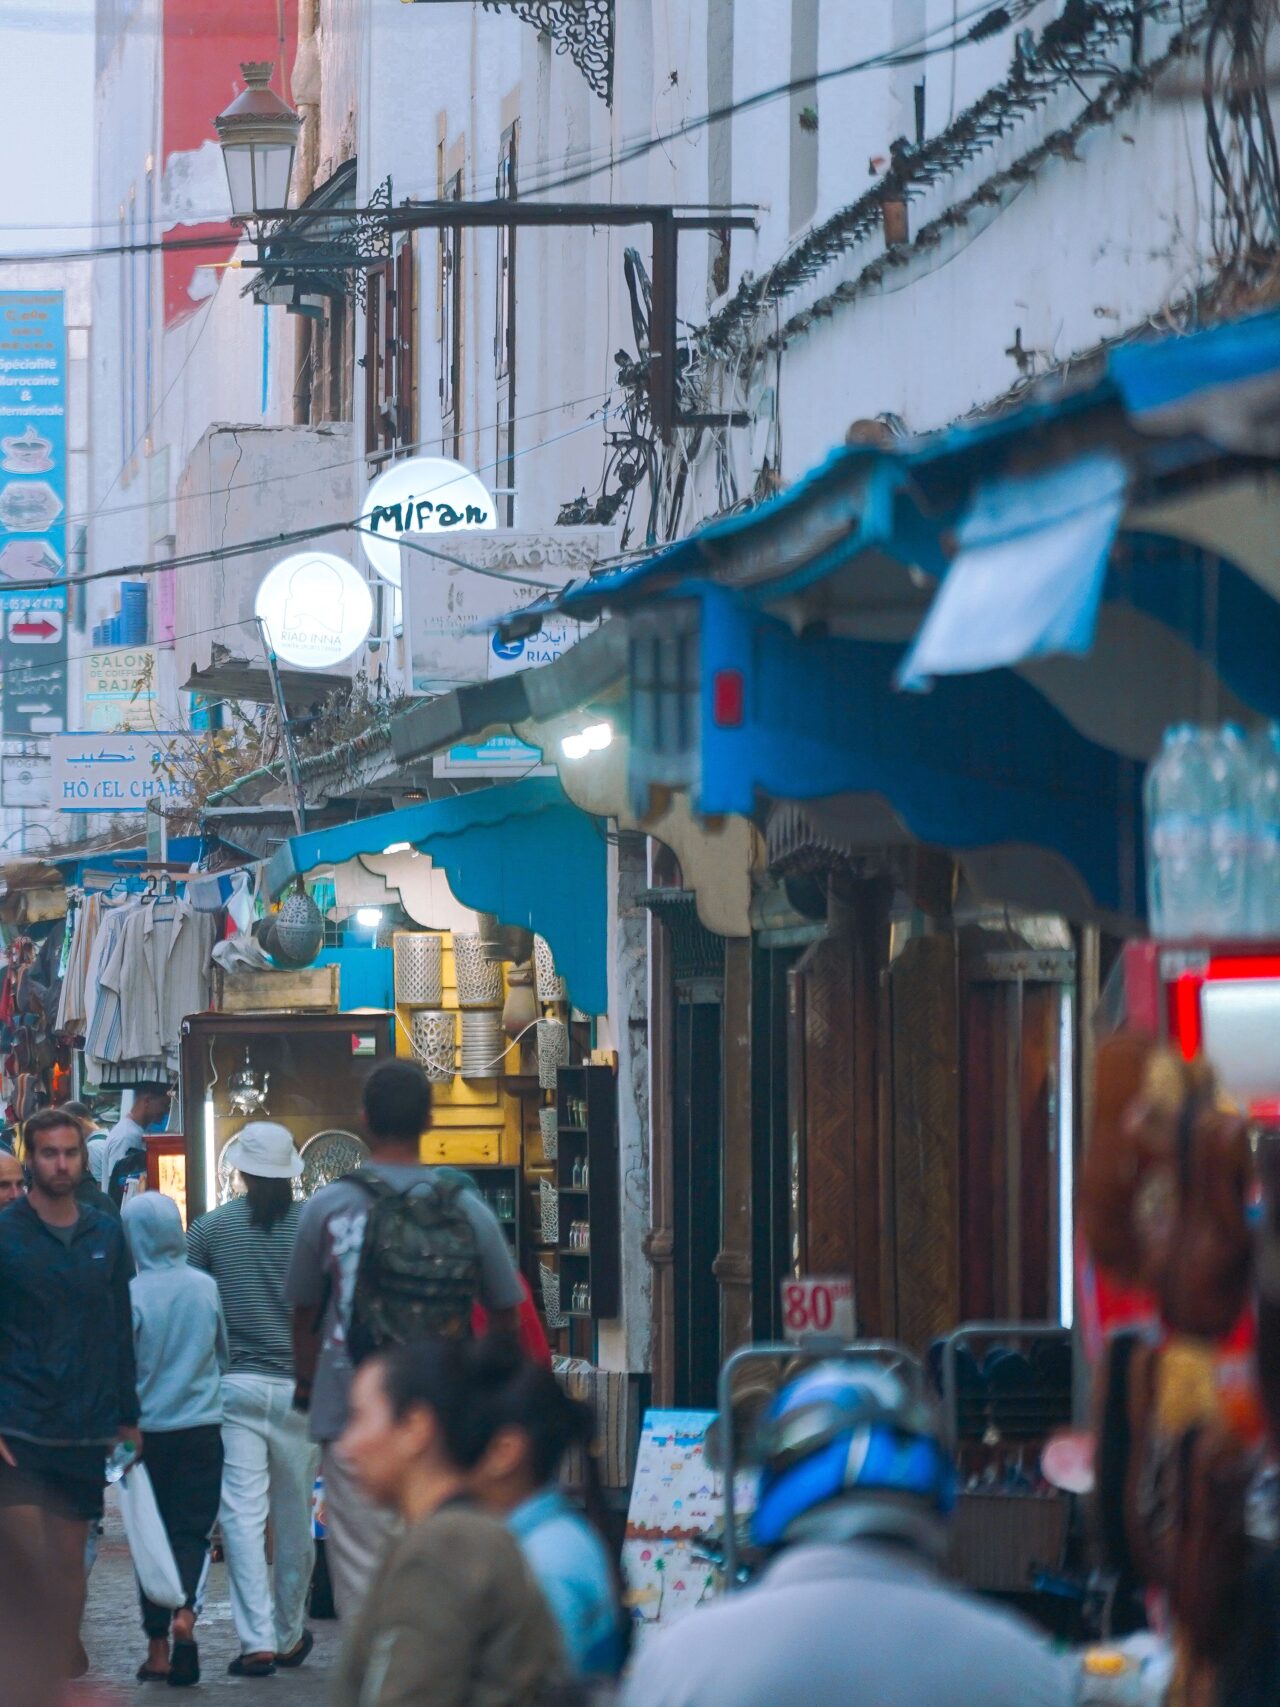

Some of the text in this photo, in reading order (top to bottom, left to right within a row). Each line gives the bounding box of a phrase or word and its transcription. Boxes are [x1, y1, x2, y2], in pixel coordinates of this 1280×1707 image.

[21, 390, 32, 401] &
[281, 631, 341, 647] RIAD INNA
[785, 1285, 832, 1331] 80
